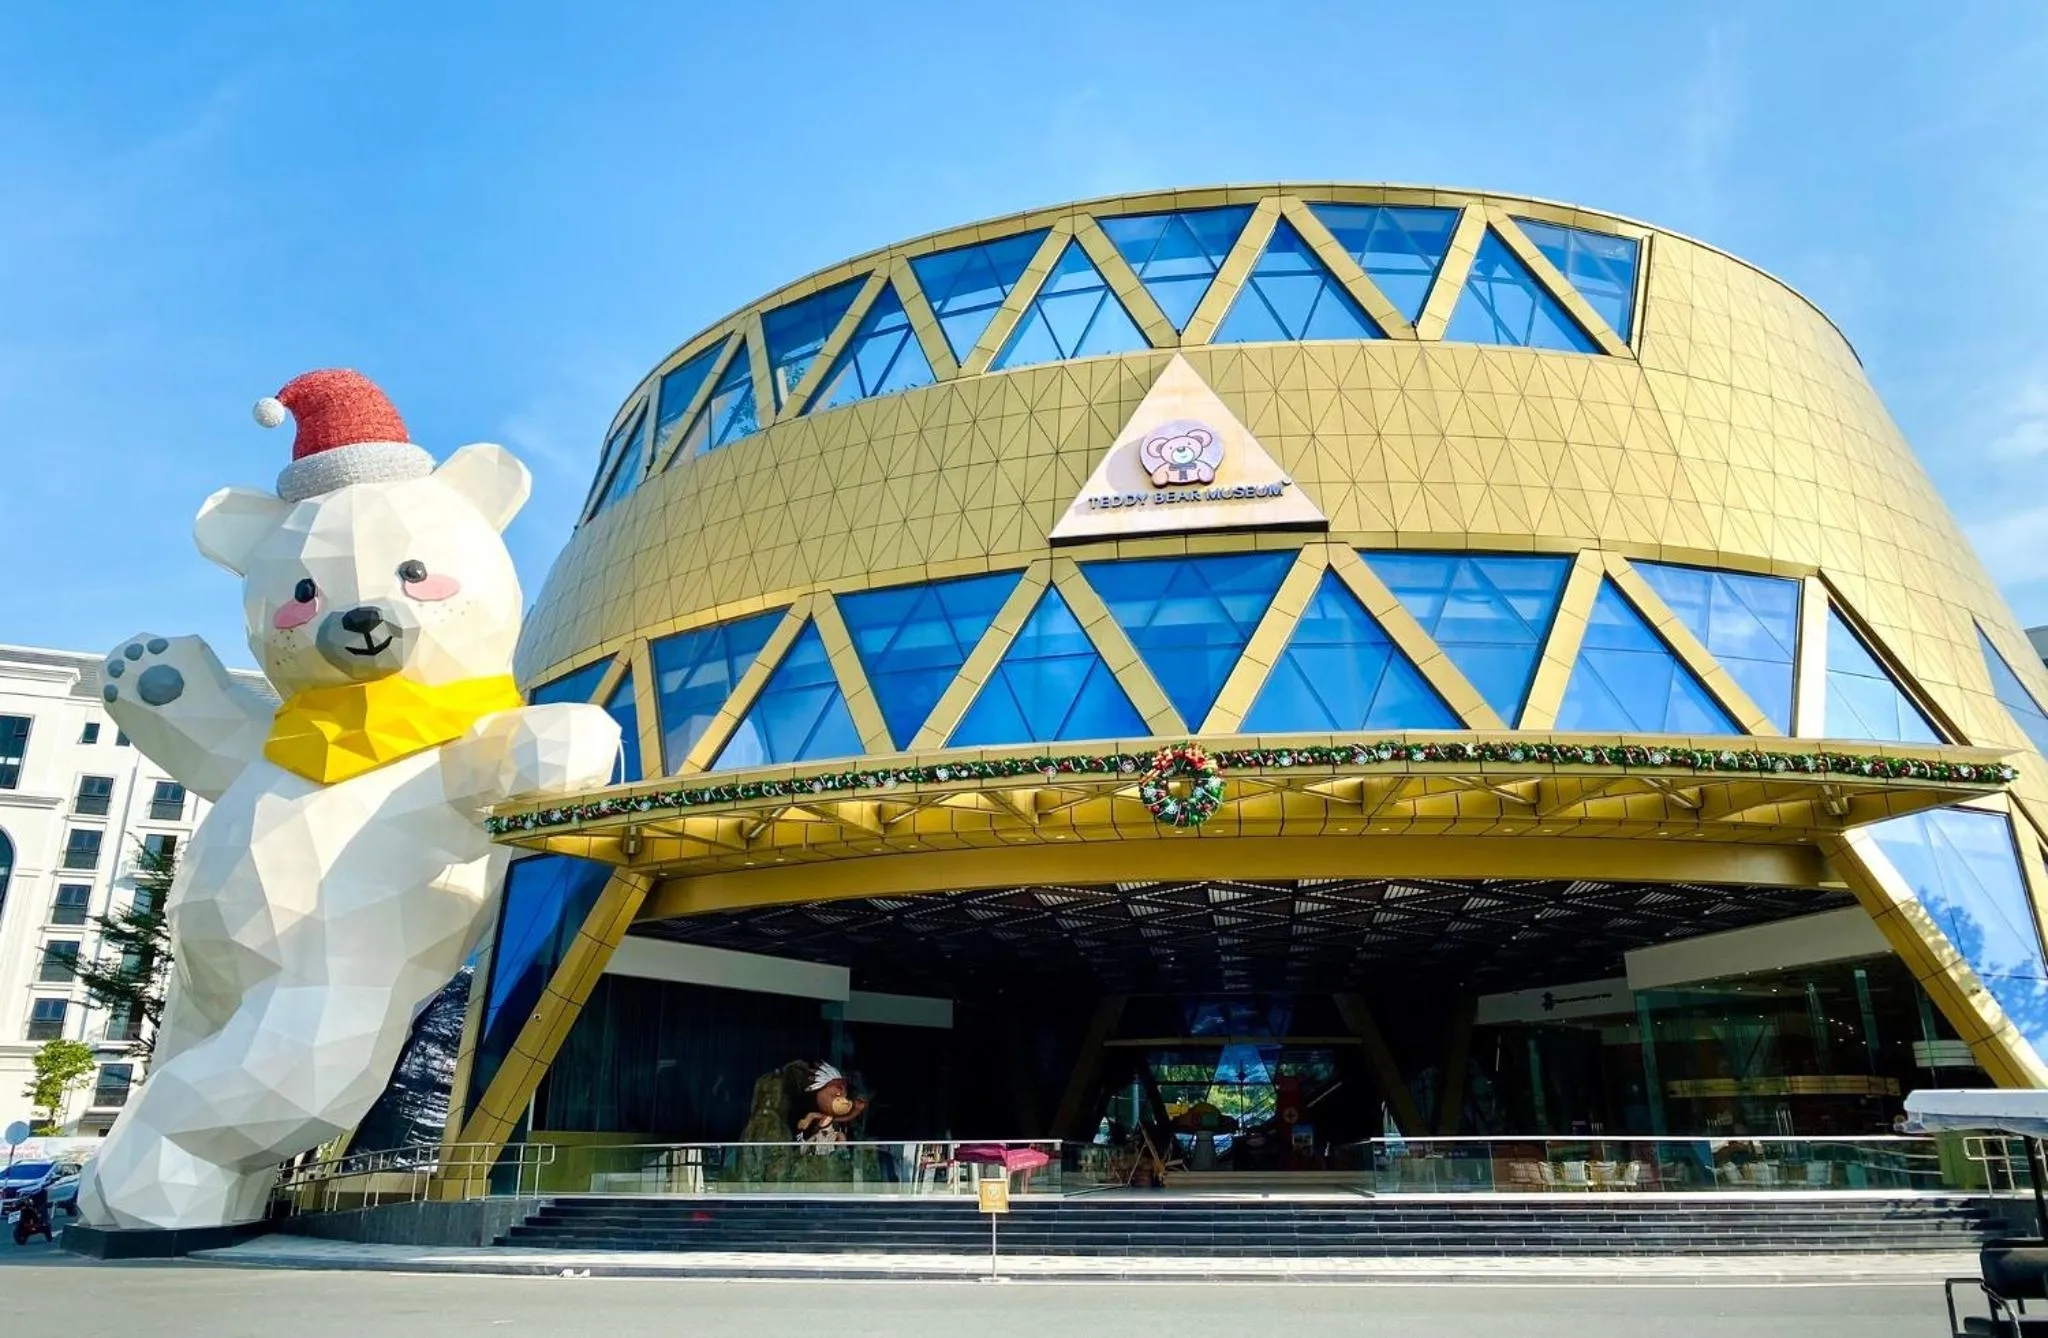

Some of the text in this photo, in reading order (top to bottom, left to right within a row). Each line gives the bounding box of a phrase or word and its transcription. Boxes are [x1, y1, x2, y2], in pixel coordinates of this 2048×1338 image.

[1088, 484, 1283, 510] TEDDY BEAR MUSEUM
